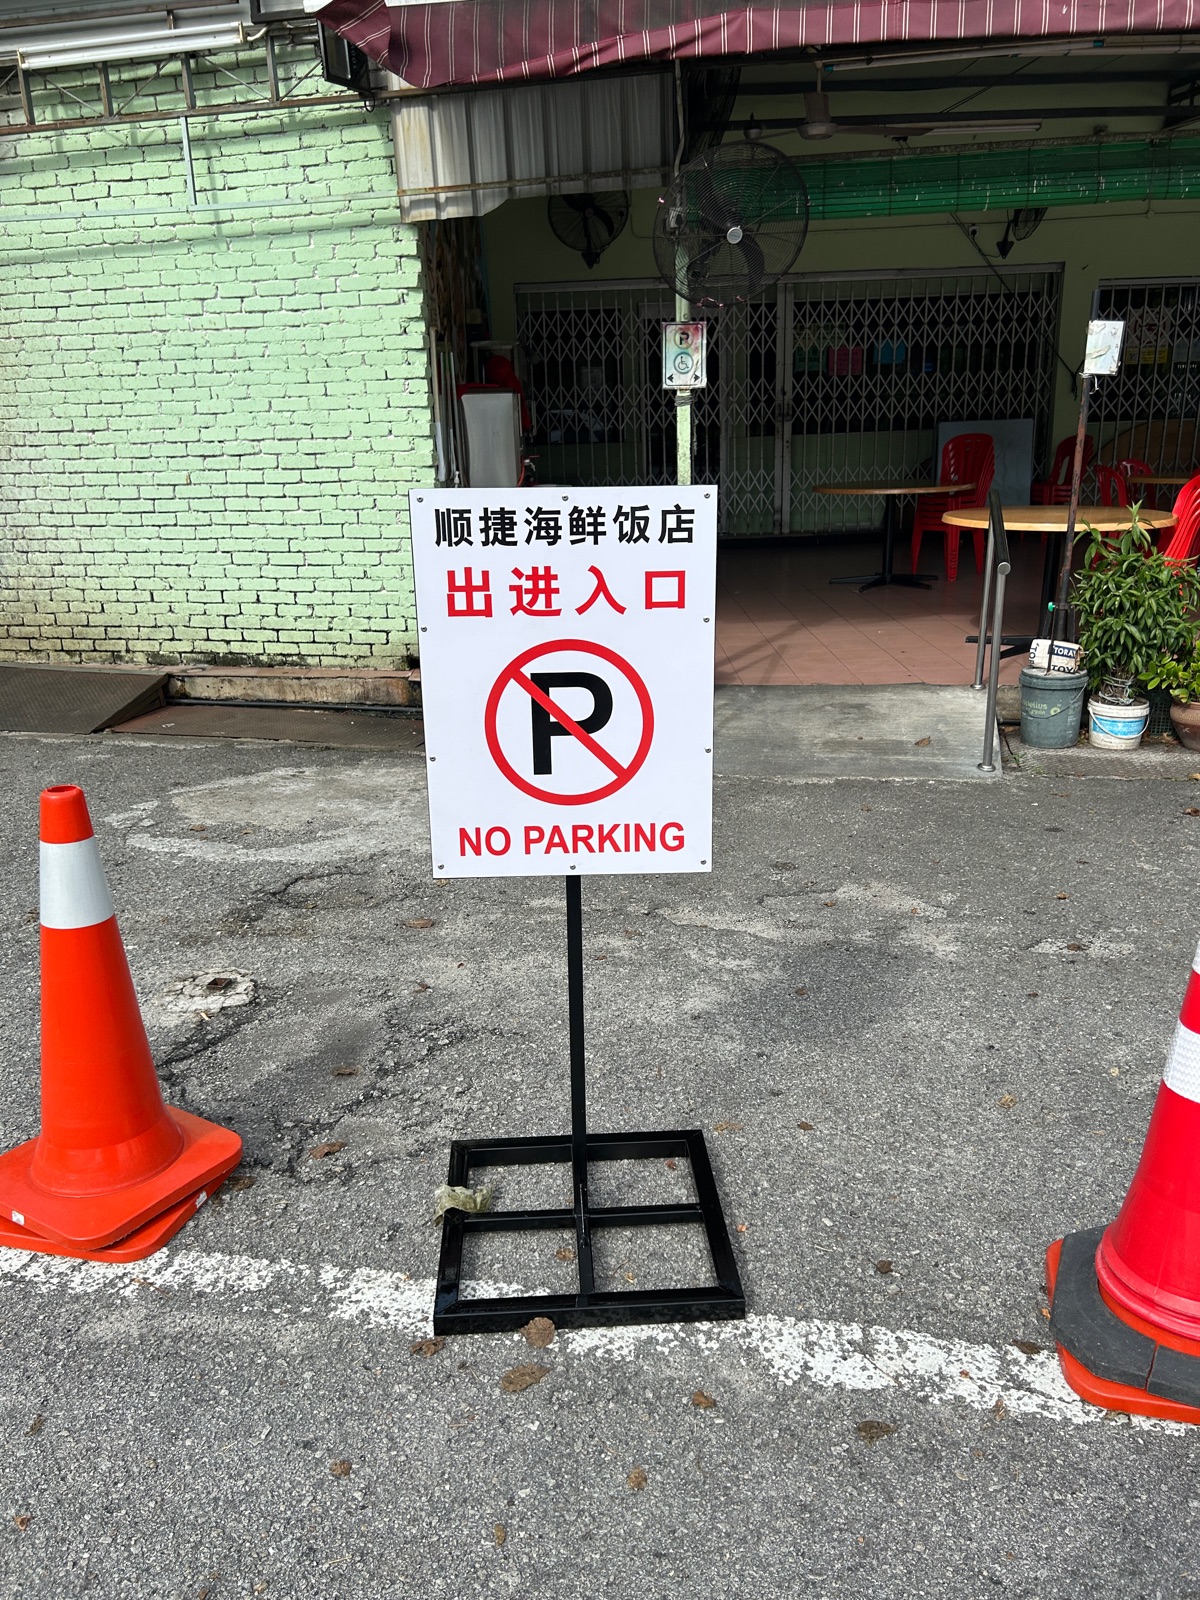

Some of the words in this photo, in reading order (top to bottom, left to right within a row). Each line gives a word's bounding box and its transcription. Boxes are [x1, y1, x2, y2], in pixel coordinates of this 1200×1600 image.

[435, 504, 695, 547] 顺捷海鲜饭店
[447, 565, 686, 618] 出进入口
[459, 826, 512, 857] NO
[523, 821, 685, 855] PARKING
